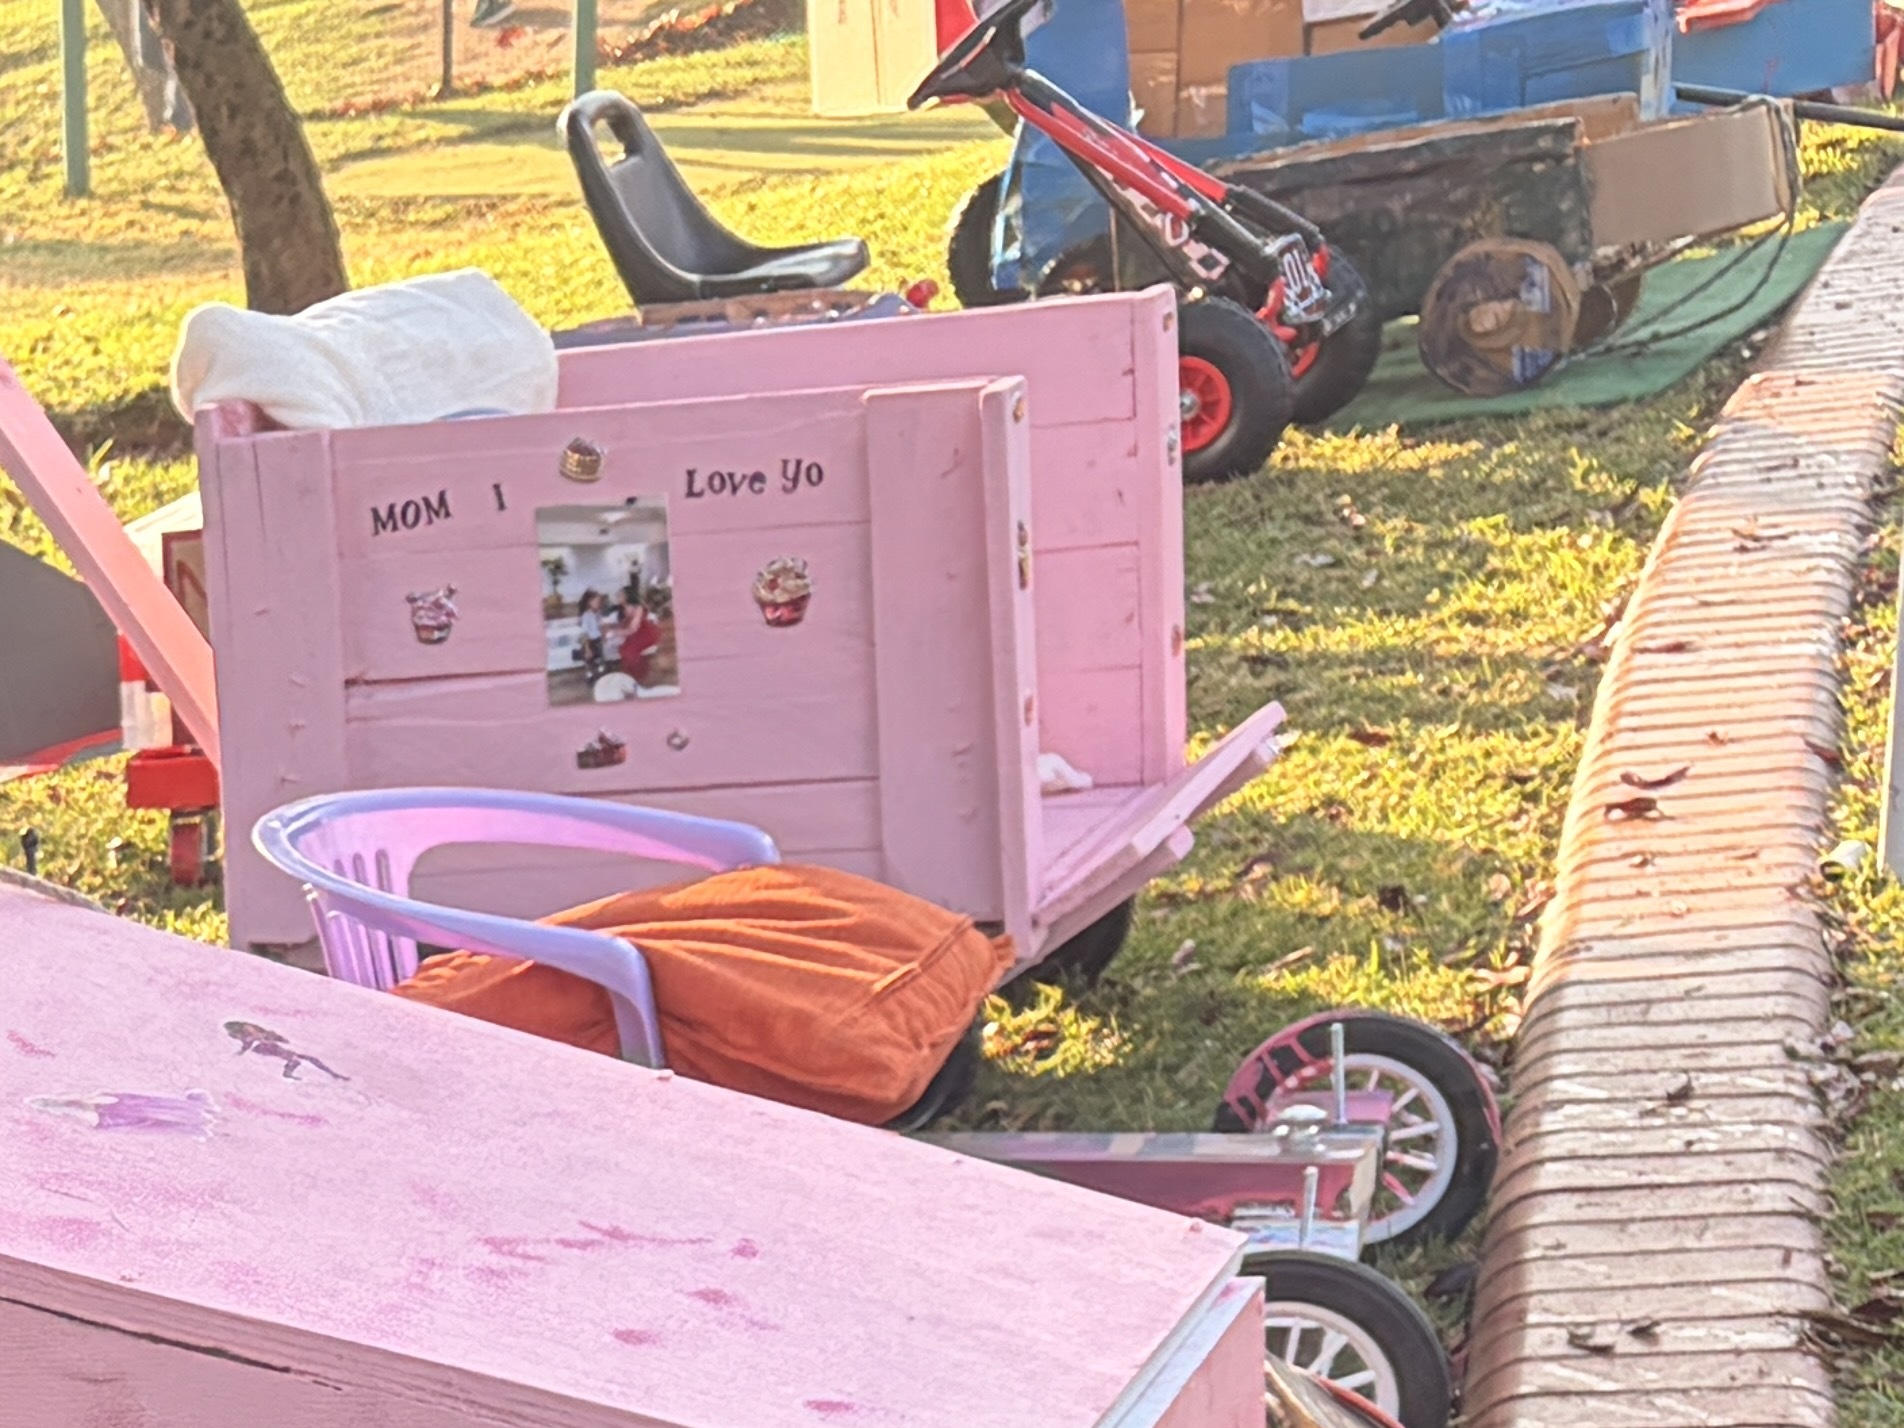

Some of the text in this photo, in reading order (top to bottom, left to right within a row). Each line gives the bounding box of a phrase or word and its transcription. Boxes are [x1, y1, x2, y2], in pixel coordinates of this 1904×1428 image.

[370, 489, 452, 537] MOM
[492, 483, 507, 511] I
[685, 468, 768, 498] Love
